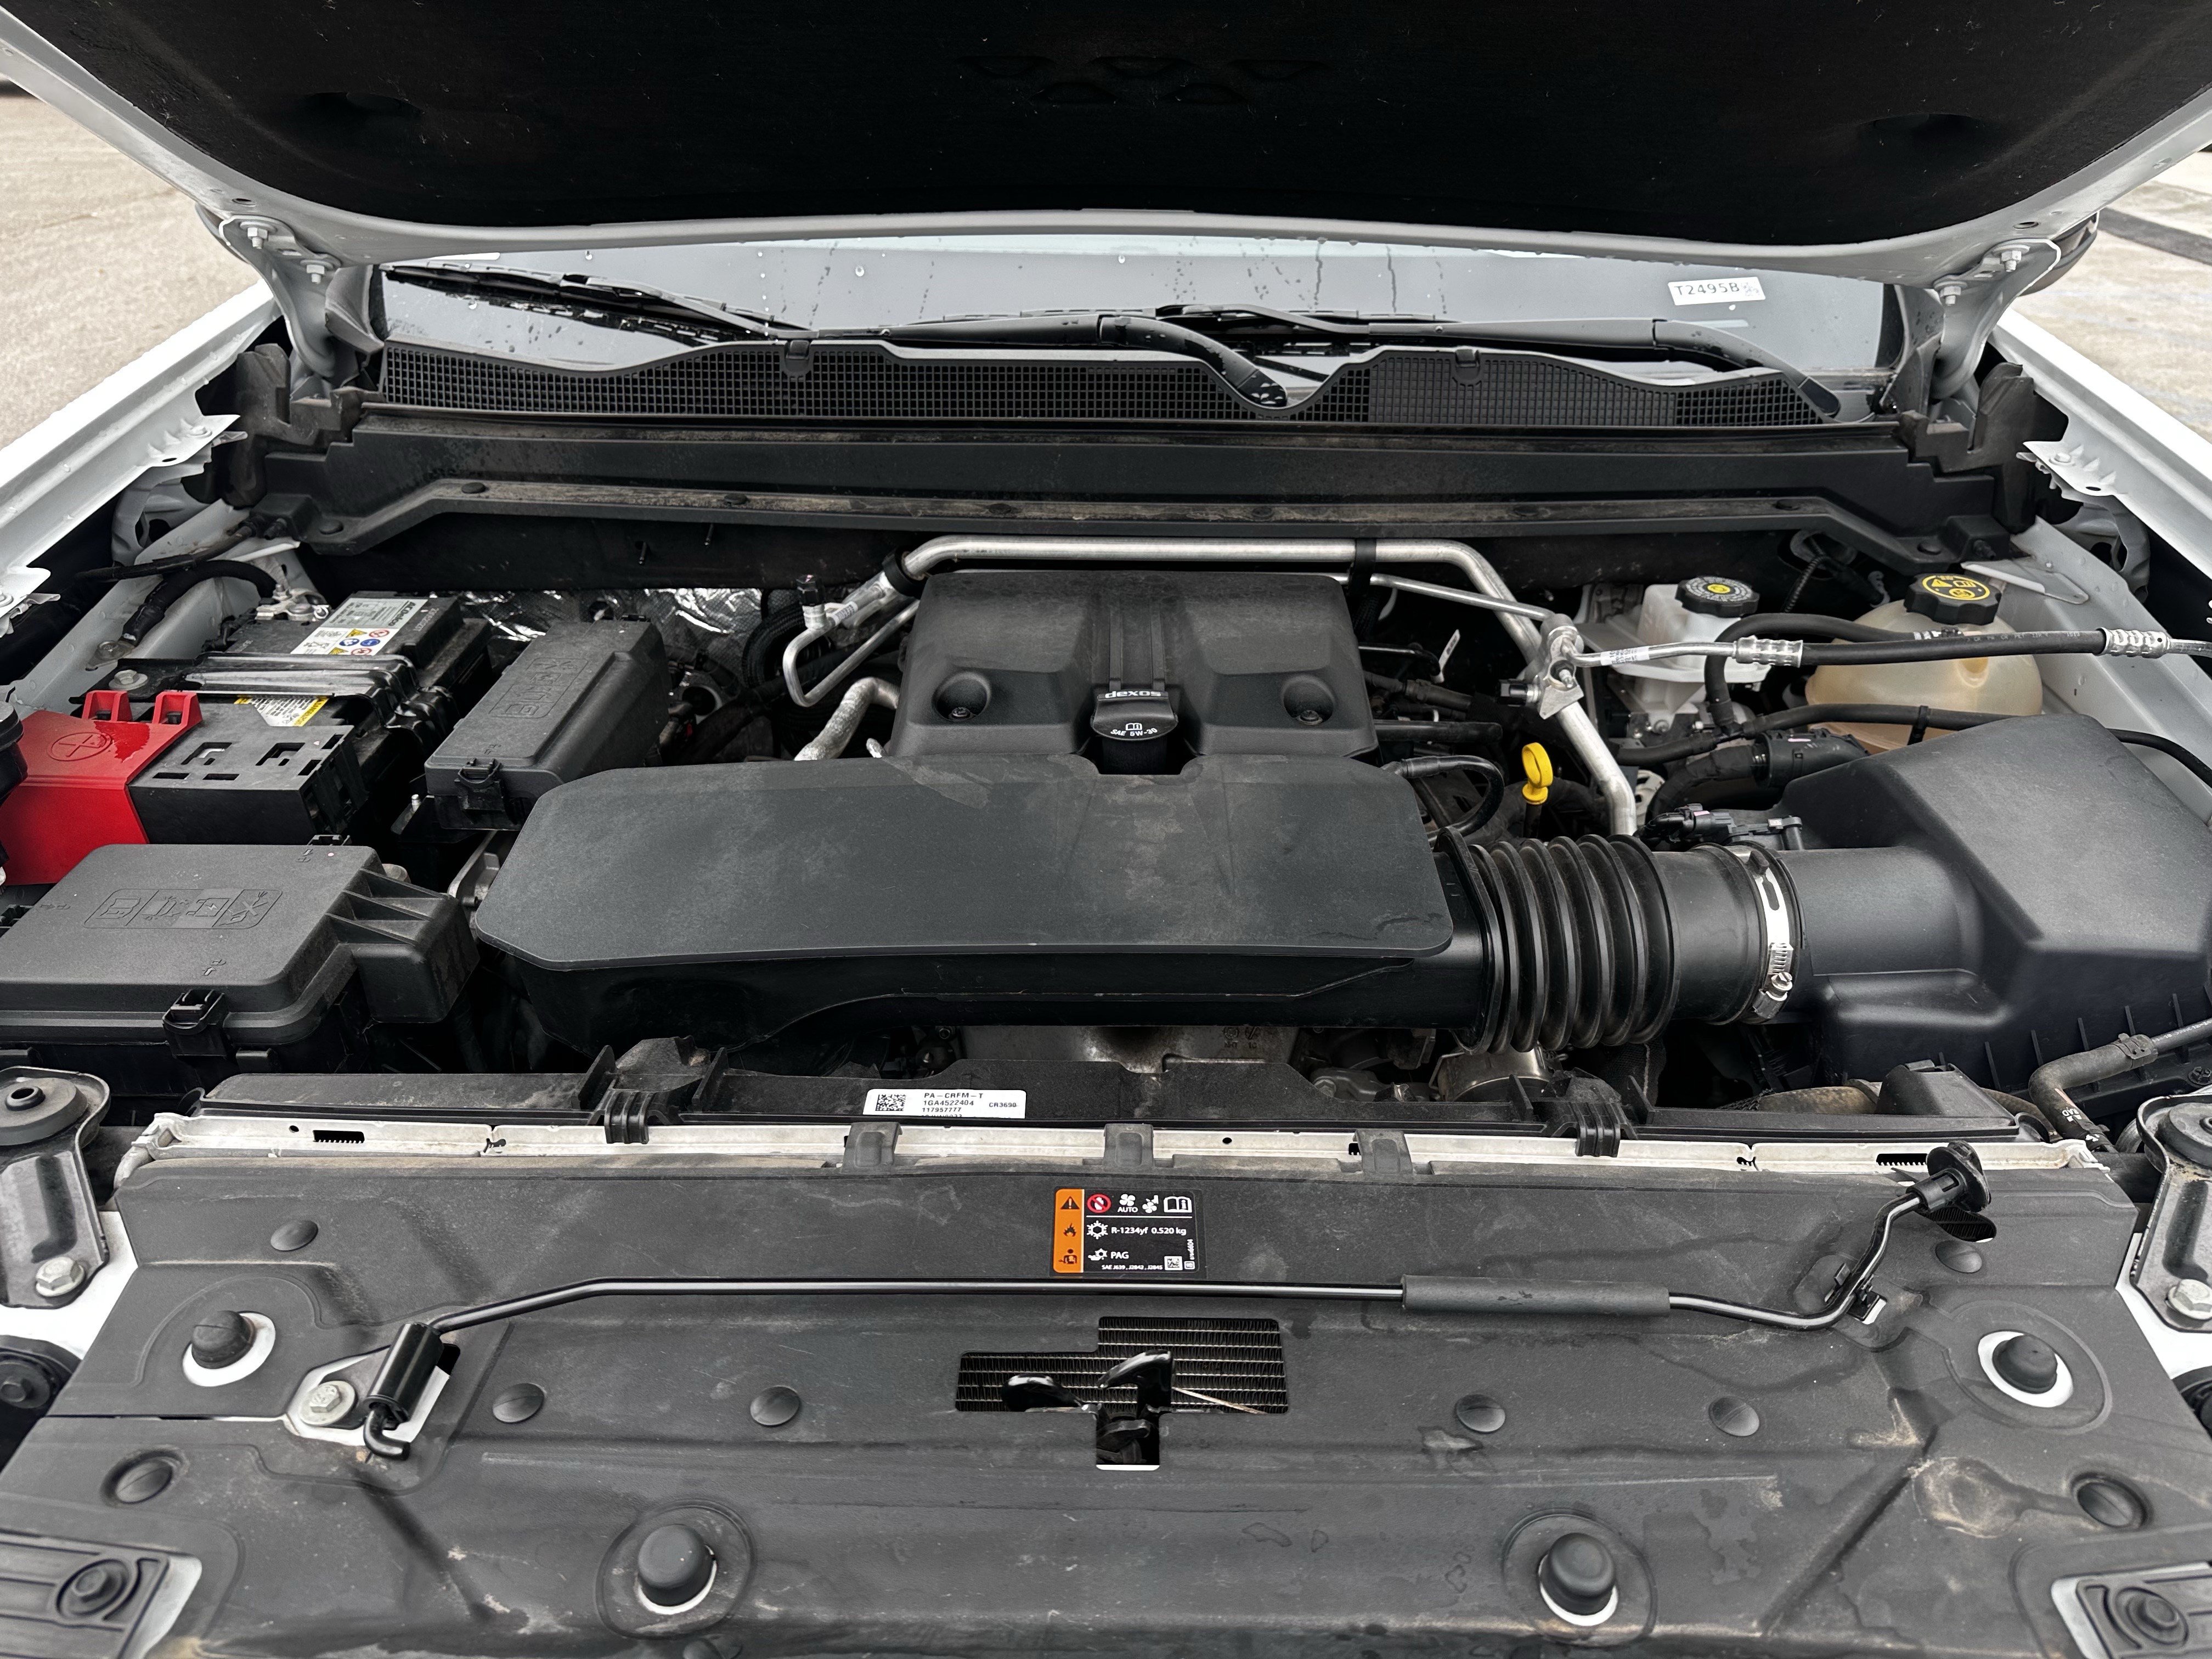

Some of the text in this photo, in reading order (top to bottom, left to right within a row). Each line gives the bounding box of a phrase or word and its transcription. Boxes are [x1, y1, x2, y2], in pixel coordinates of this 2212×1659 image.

[388, 601, 416, 627] ACDelco
[1105, 691, 1161, 699] dexos
[1111, 1227, 1149, 1235] R-1234yf
[1176, 1227, 1187, 1236] kg
